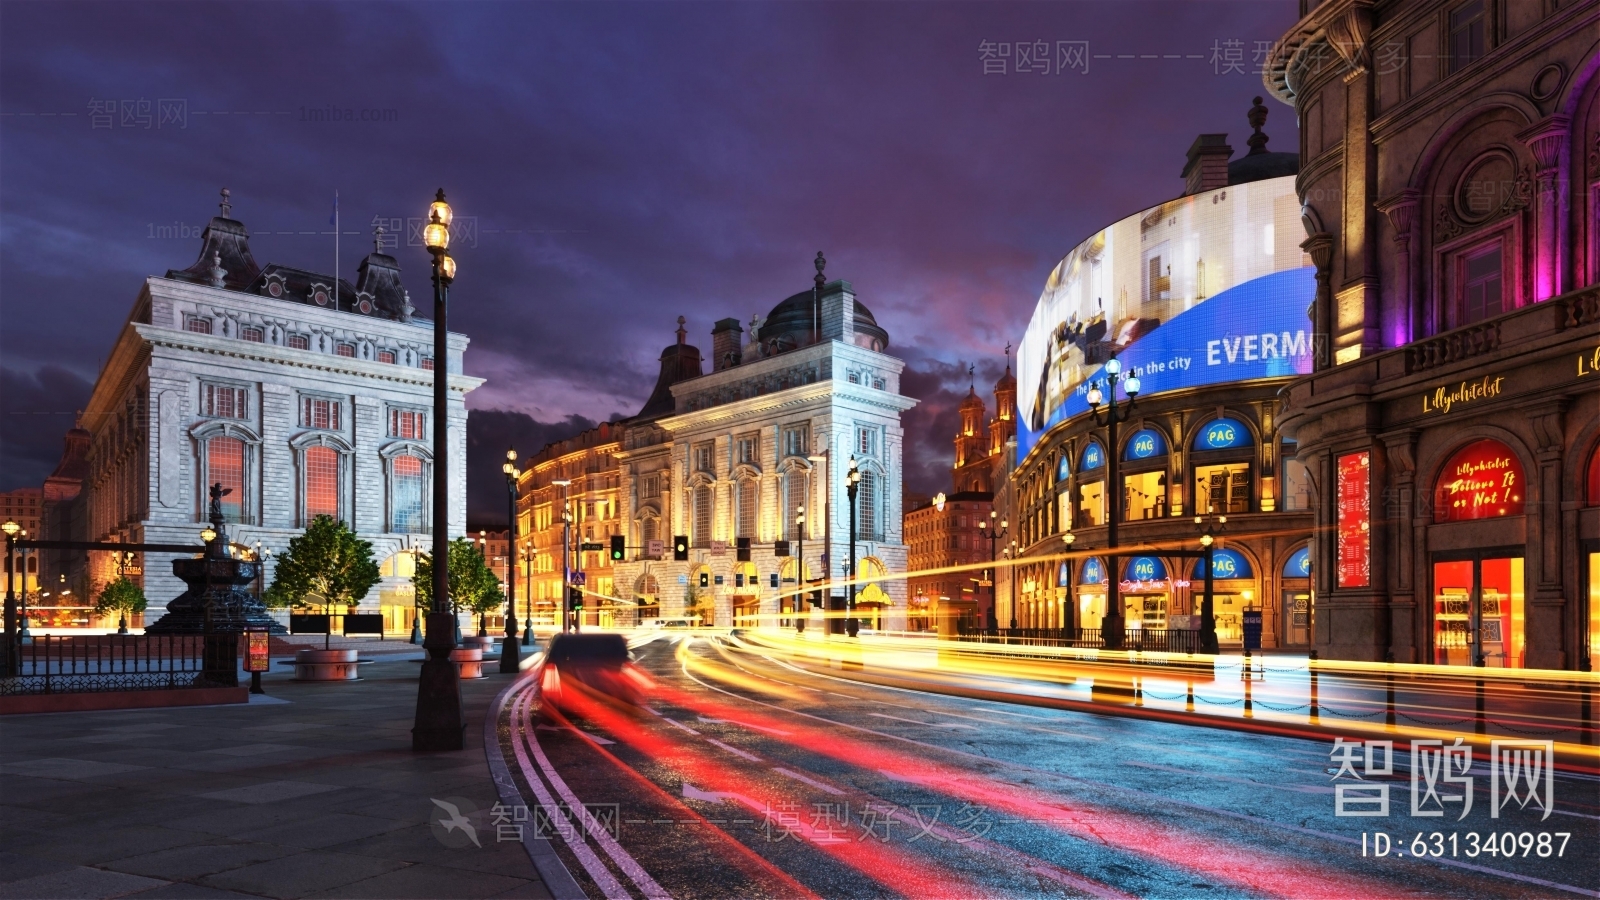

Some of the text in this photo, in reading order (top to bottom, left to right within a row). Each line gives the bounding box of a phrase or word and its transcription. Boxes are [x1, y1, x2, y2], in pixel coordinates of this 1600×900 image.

[1076, 385, 1088, 397] The
[1088, 378, 1104, 392] bst
[1134, 366, 1144, 377] in
[1147, 361, 1165, 375] the
[1168, 356, 1192, 371] city
[1422, 375, 1506, 414] Lillywhitelist
[1209, 429, 1234, 442] PAG
[1136, 440, 1153, 452] PAG
[1087, 453, 1098, 463] PAG
[1450, 471, 1516, 495] Believe It
[1453, 498, 1467, 509] or
[1473, 491, 1498, 508] Not
[1135, 564, 1153, 574] PAG
[1212, 560, 1234, 572] PAG
